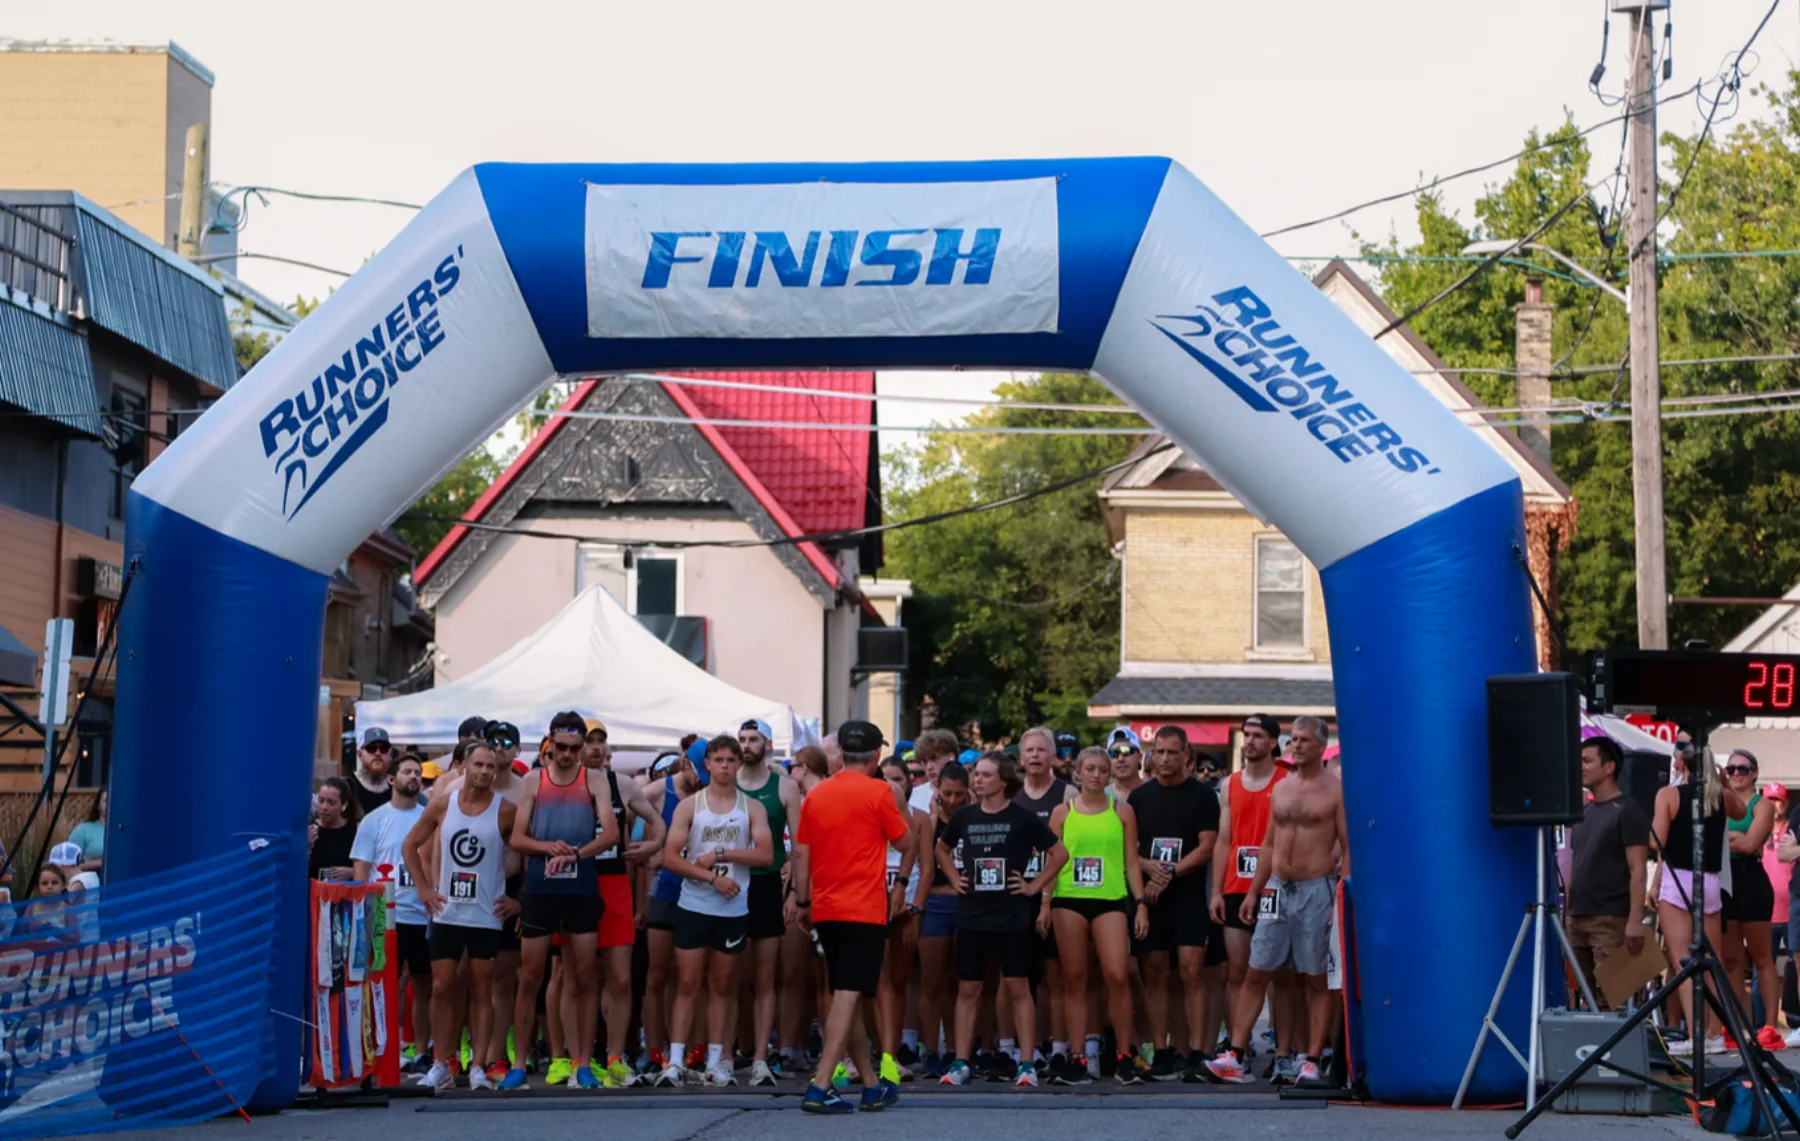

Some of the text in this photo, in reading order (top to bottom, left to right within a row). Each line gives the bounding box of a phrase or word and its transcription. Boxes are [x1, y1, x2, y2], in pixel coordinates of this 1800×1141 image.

[641, 228, 1002, 289] FINISH
[259, 244, 464, 458] RUNNERS'
[1210, 285, 1441, 475] RUNNERS'
[302, 308, 446, 458] CHOICE
[1214, 330, 1374, 464] CHOICE
[1744, 662, 1796, 708] 28
[981, 869, 997, 884] 95
[1077, 866, 1099, 881] 145
[1160, 847, 1172, 862] 71
[453, 881, 472, 897] 191
[15, 977, 180, 1068] CHOICE
